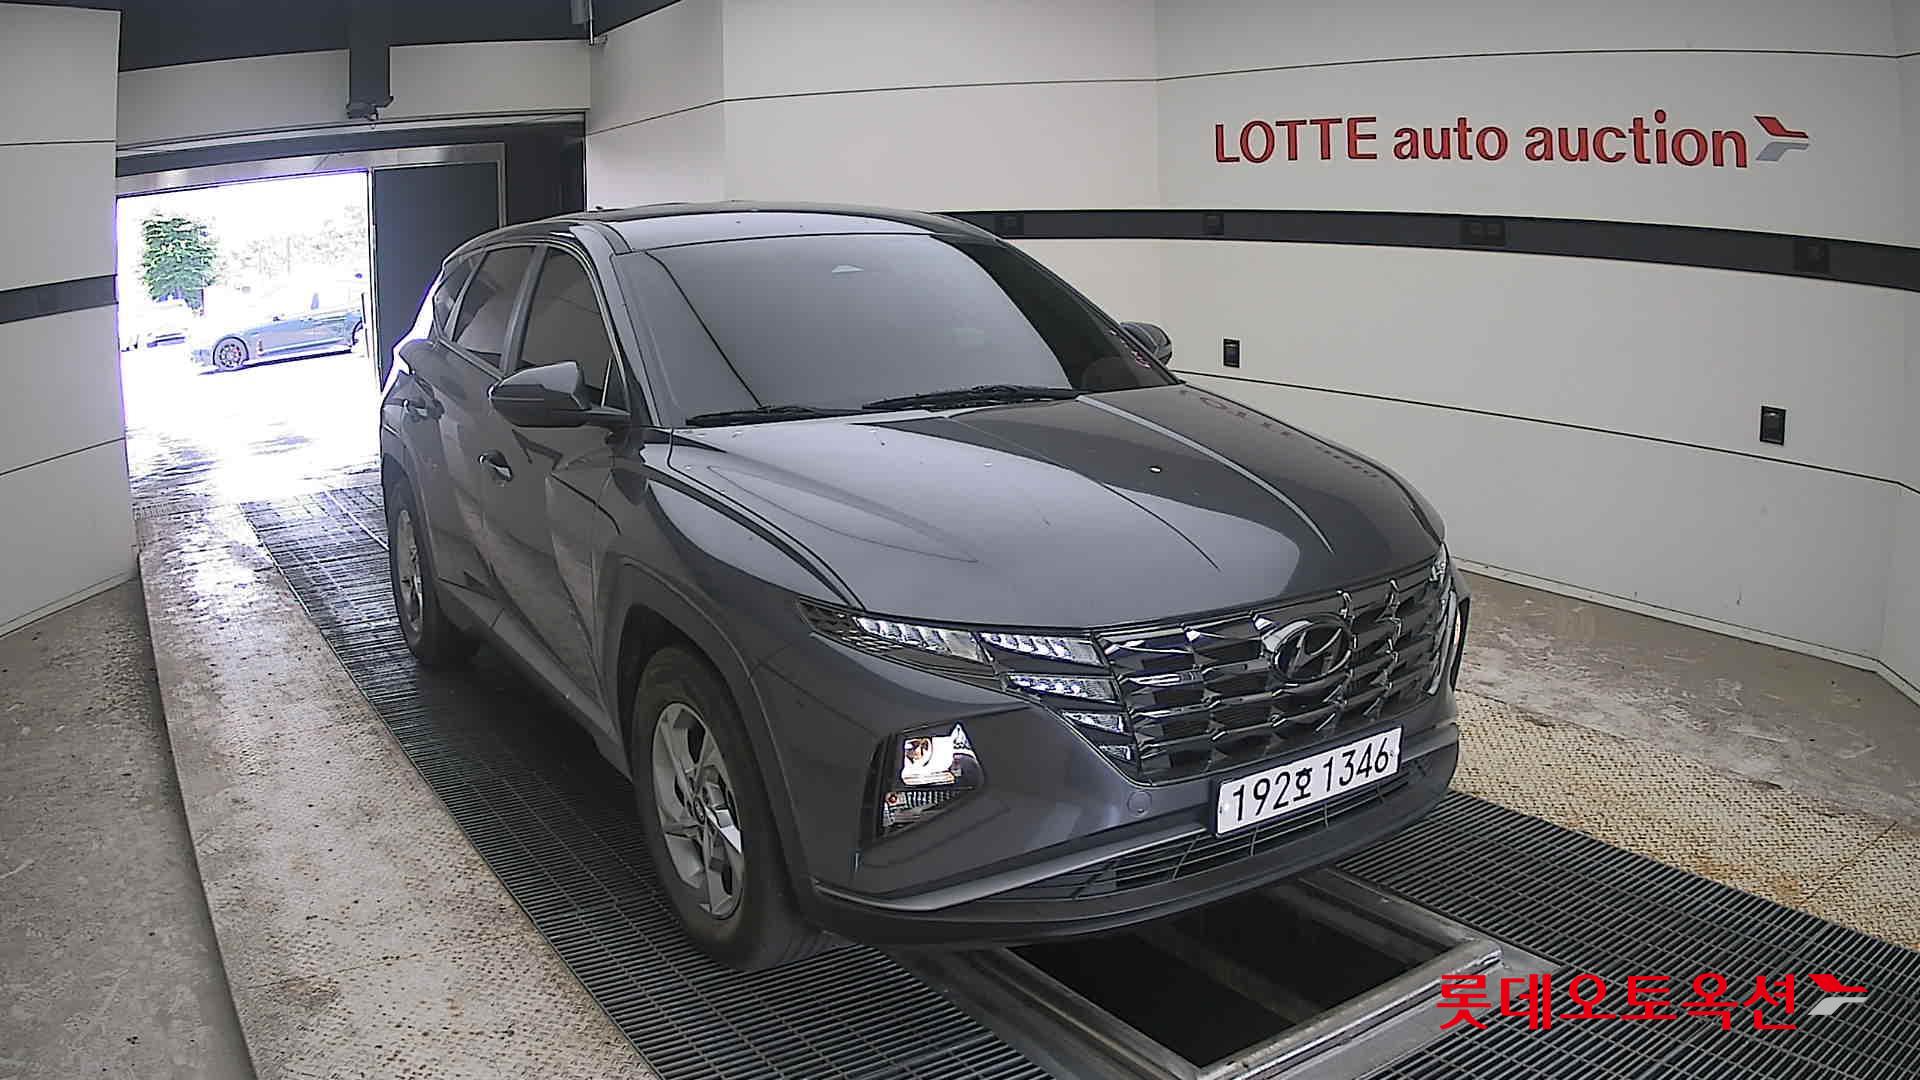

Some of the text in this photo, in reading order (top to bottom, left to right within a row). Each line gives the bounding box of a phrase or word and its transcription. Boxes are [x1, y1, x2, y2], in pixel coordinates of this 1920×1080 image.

[1215, 109, 1748, 168] LOTTE auto auction
[1233, 738, 1390, 821] 192호 1346
